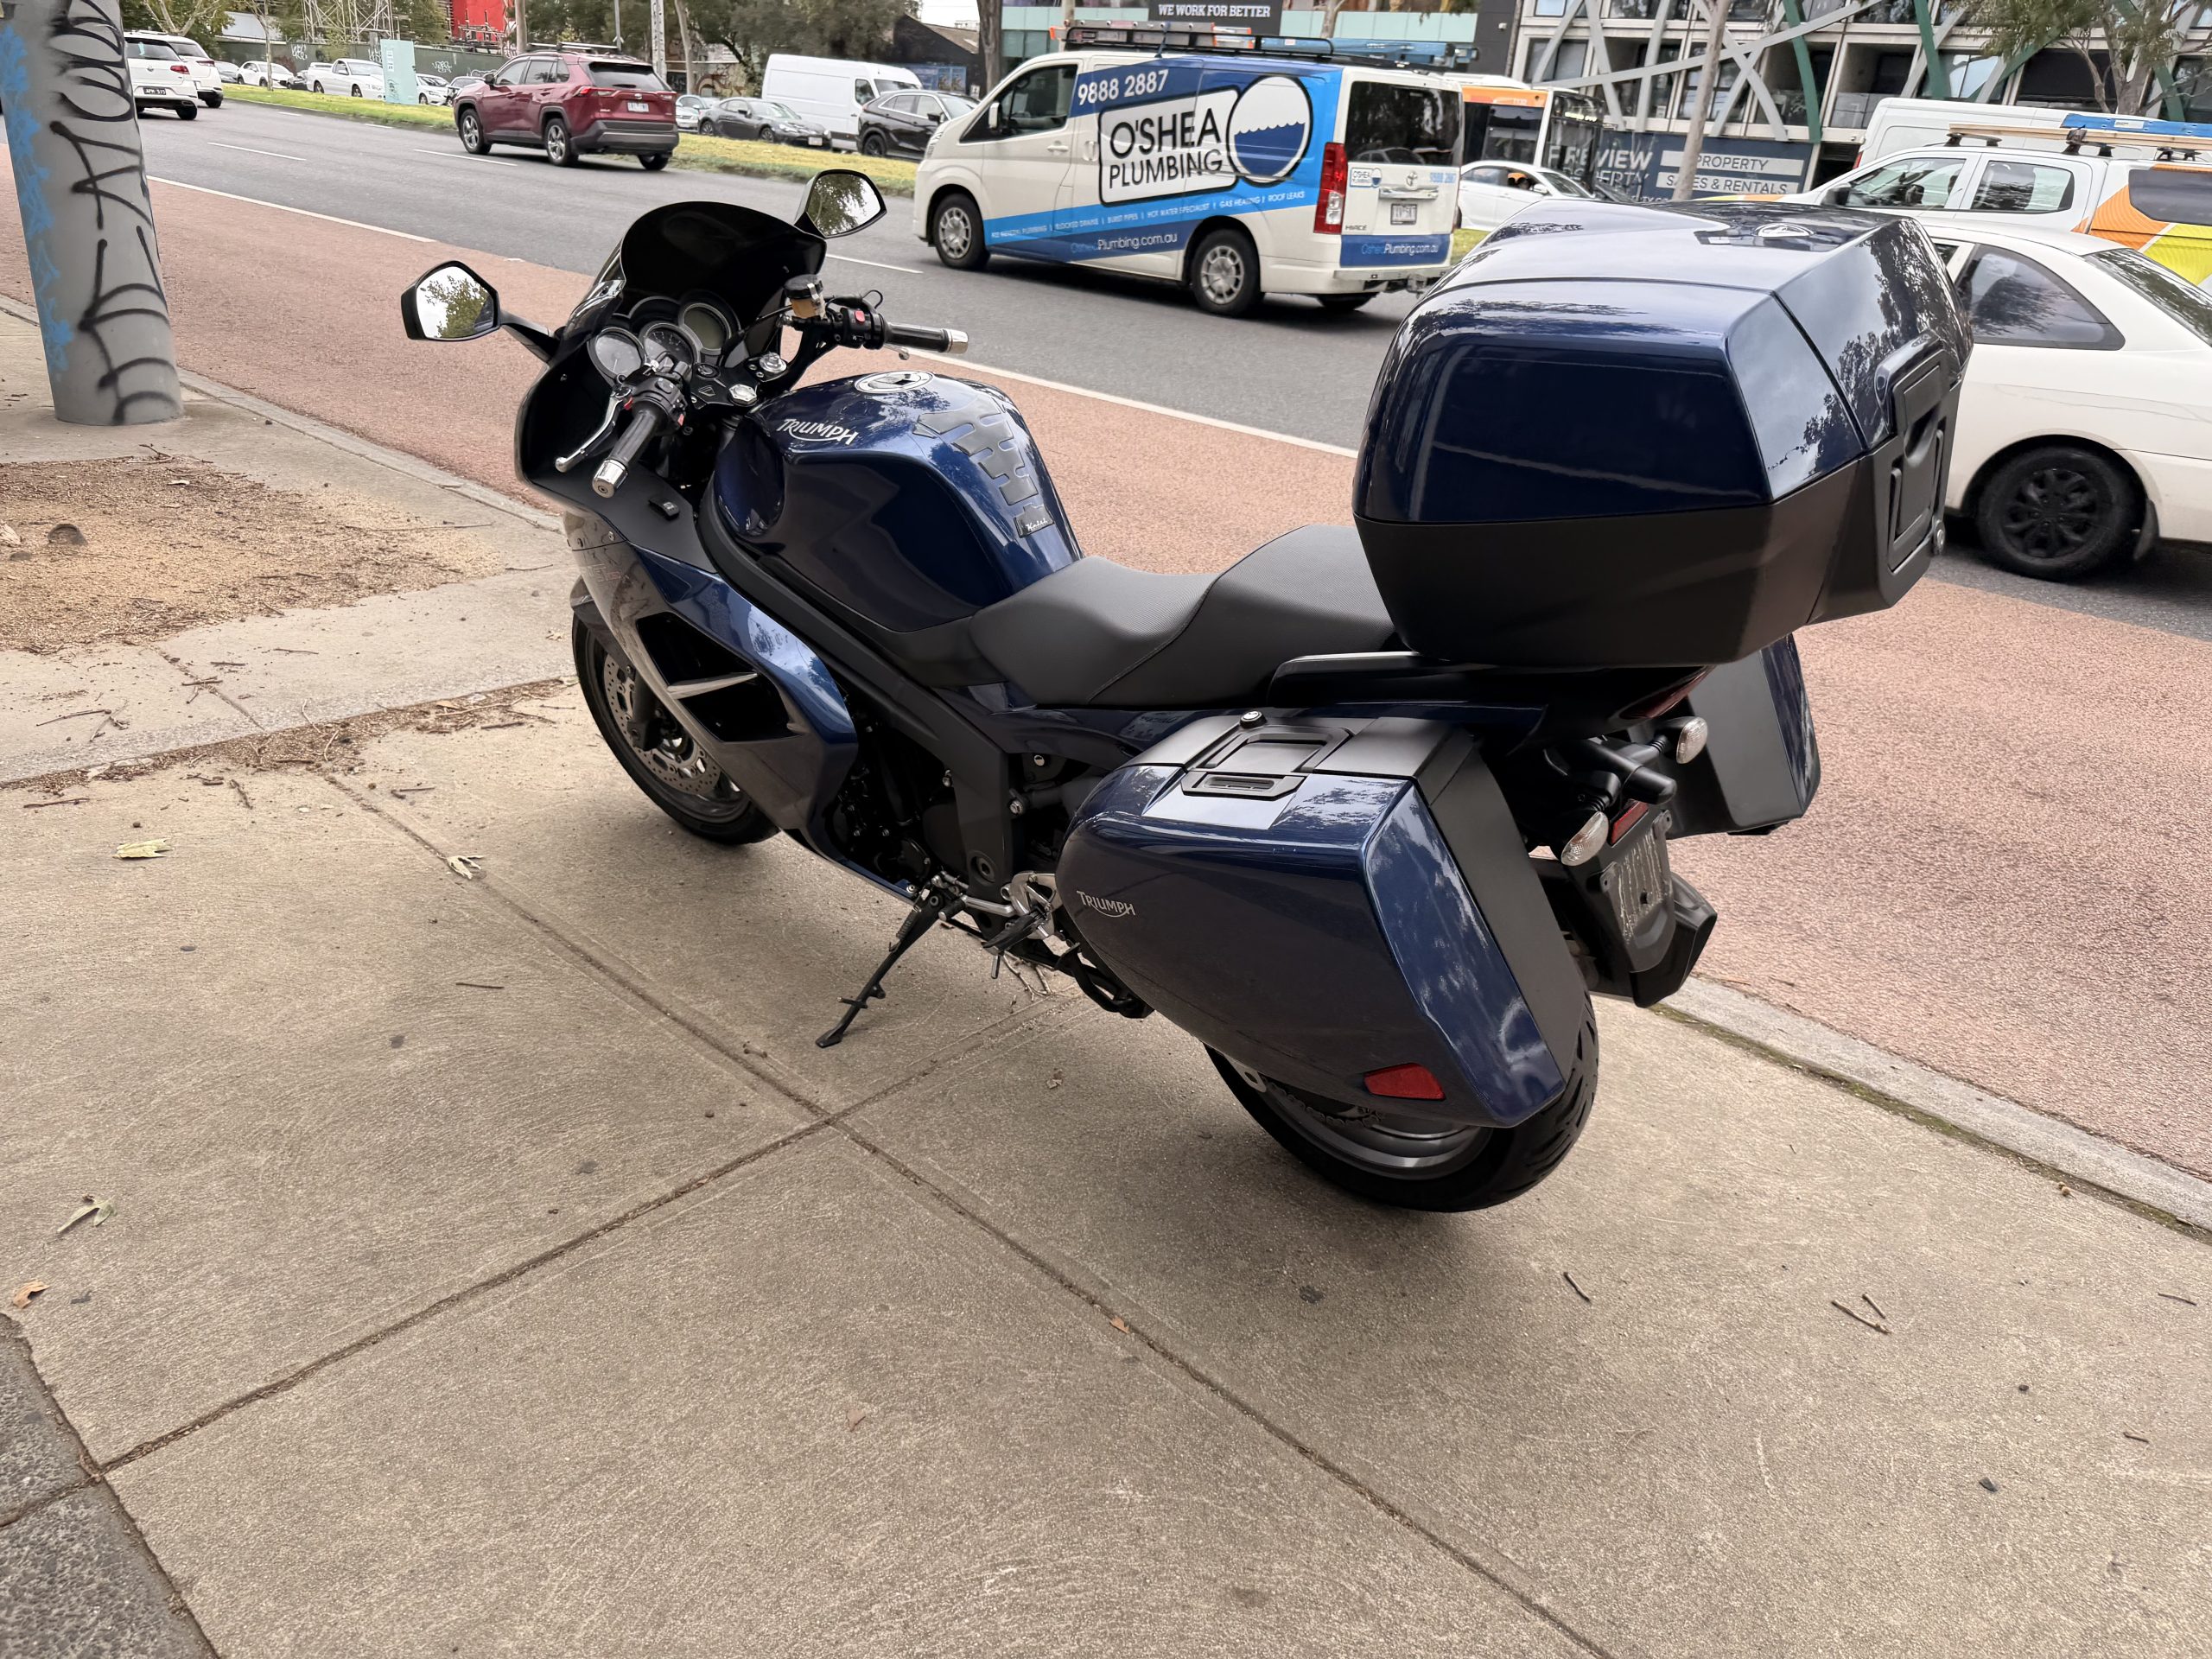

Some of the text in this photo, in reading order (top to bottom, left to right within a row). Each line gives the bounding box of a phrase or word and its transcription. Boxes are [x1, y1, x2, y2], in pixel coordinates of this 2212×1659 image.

[1158, 4, 1270, 17] WE WORK FOR BETTER
[1077, 69, 1168, 105] 9888 2887
[1110, 108, 1221, 159] O'SHEA
[1109, 149, 1223, 188] PLUMBING
[1697, 153, 1769, 171] PROPERTY
[1268, 190, 1306, 202] ROOF LEAKS
[1666, 175, 1788, 195] SES & RENTALS
[1219, 200, 1233, 208] GAS
[776, 418, 859, 445] TRIUMPH
[1076, 890, 1136, 918] TRIUMPH
